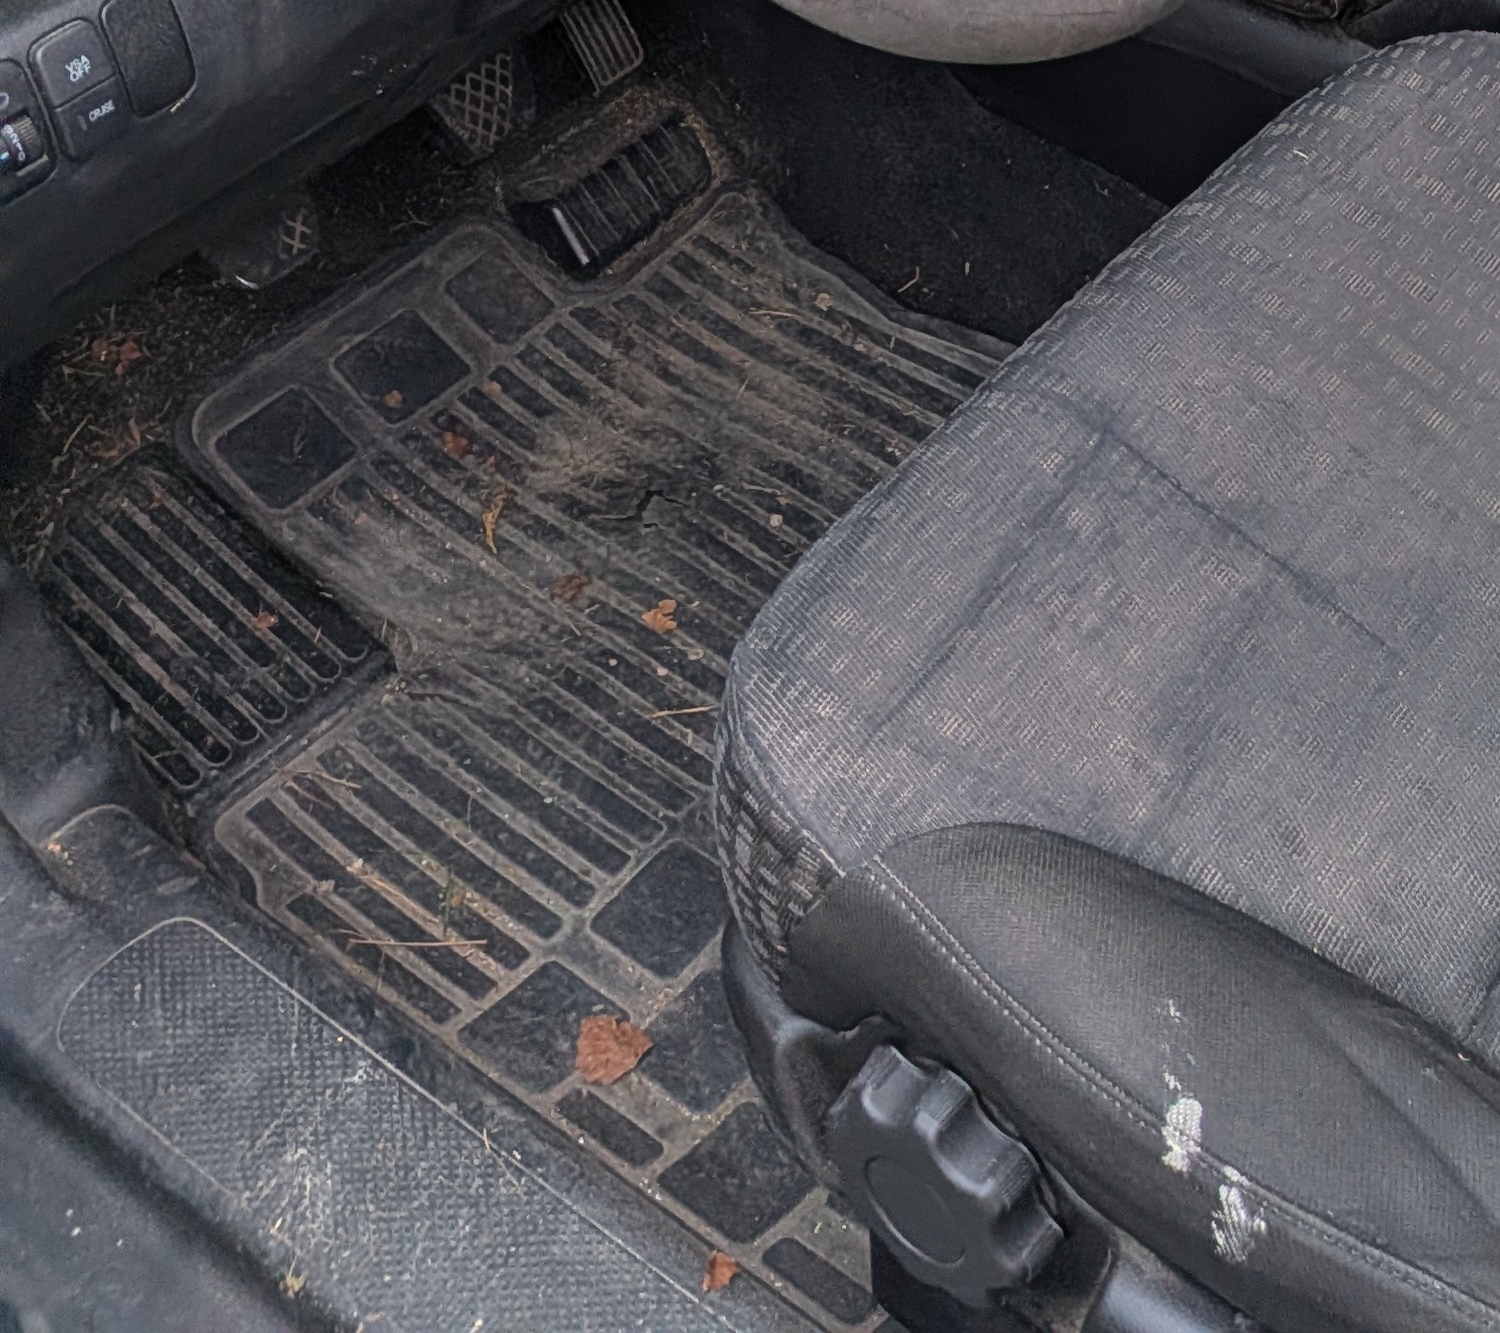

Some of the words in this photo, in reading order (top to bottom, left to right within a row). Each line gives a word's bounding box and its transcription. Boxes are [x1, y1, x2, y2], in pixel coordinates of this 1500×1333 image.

[65, 55, 90, 74] VSA
[70, 64, 91, 82] OFF
[89, 100, 115, 121] CRUISE
